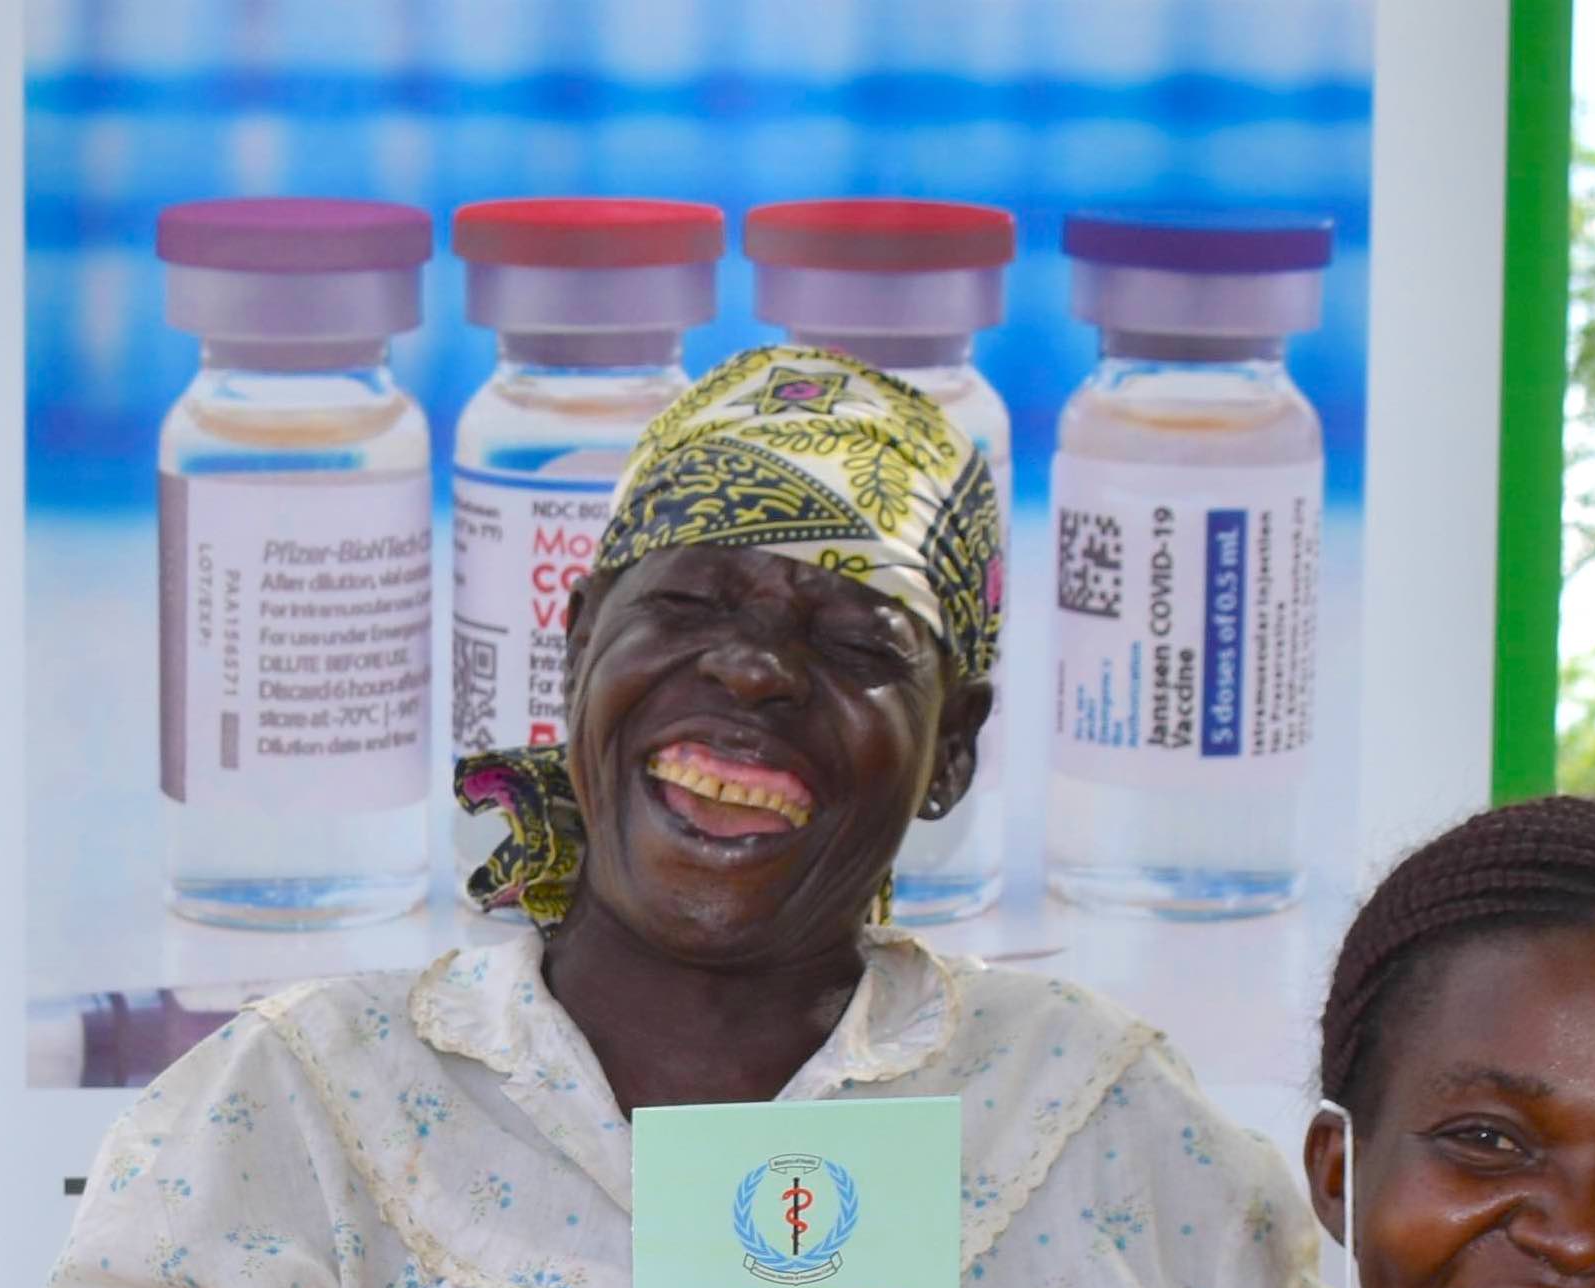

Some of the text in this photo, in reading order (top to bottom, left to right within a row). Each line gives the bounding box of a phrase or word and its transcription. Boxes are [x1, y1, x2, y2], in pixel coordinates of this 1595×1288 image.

[260, 627, 286, 646] For
[1147, 507, 1174, 748] Janssen COVID-19
[1210, 530, 1241, 745] 5 doses of 0.5 mL
